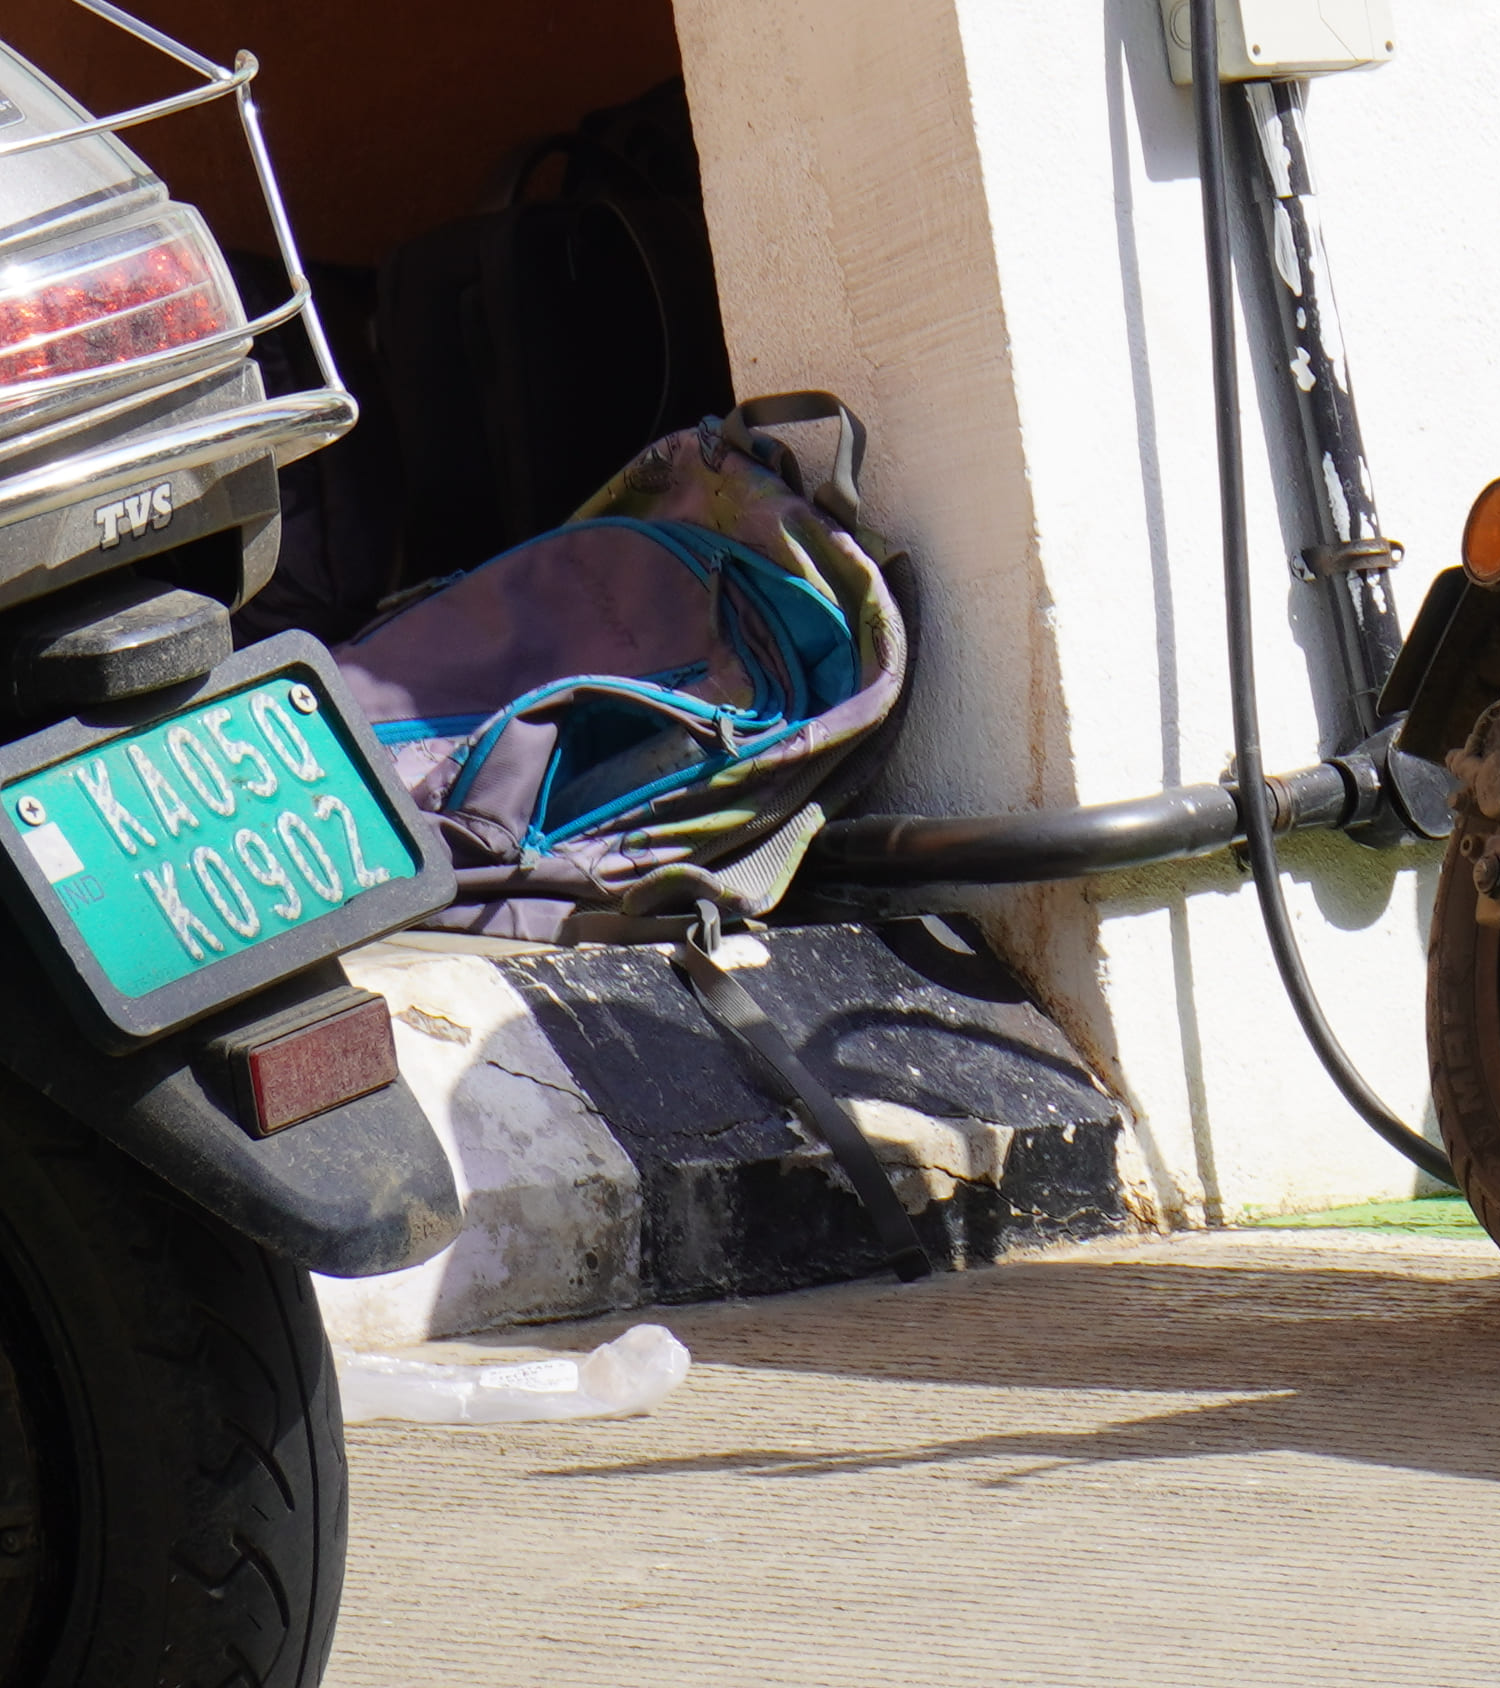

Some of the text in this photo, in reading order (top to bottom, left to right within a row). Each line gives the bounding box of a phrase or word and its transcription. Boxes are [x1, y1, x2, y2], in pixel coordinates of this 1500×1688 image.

[96, 482, 173, 551] TVS
[76, 692, 325, 856] KA05Q
[60, 874, 106, 914] IND
[142, 794, 390, 961] K0902
